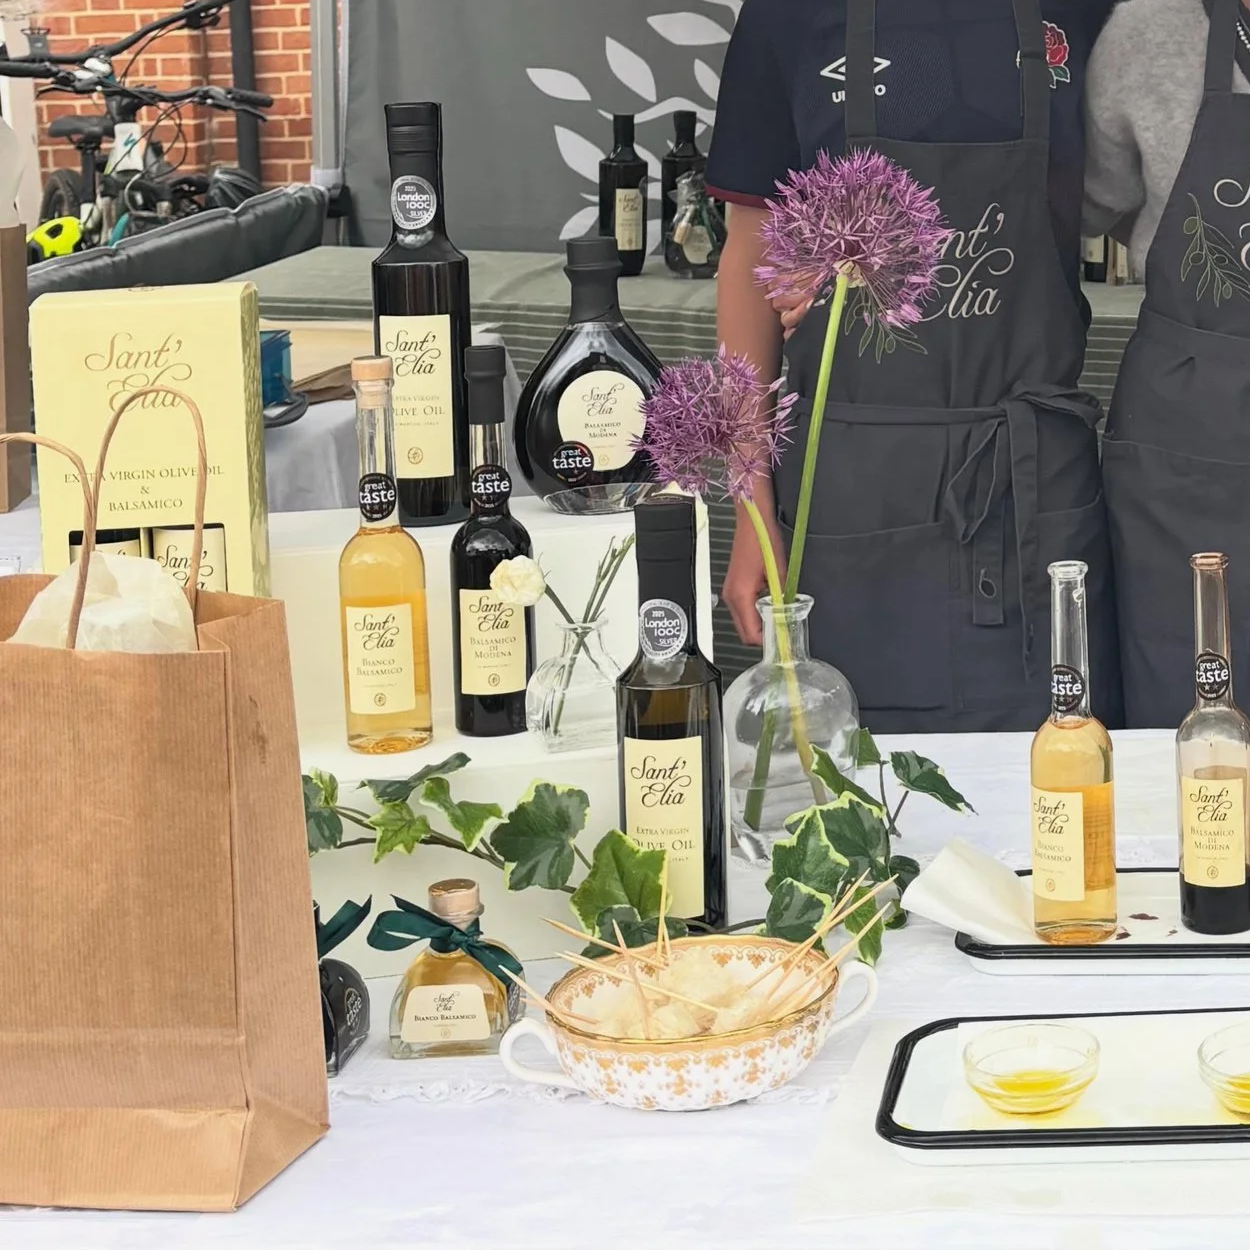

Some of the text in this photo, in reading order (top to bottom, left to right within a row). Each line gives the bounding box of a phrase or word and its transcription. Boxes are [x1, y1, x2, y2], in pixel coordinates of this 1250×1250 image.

[398, 192, 430, 201] London
[385, 330, 436, 352] Sant'
[84, 332, 183, 372] Sant'
[395, 348, 442, 377] Elia
[394, 407, 418, 416] LIVE
[560, 449, 582, 459] great
[552, 456, 592, 470] taste
[111, 468, 156, 482] VIRGIN
[158, 466, 198, 479] OLIVE
[478, 472, 500, 482] great
[140, 486, 150, 494] &
[364, 481, 386, 493] great
[471, 480, 510, 494] taste
[360, 490, 395, 504] taste
[109, 498, 183, 512] BALSAMICO
[469, 596, 506, 614] Sant
[354, 613, 396, 632] Sant'
[477, 607, 514, 632] Elia
[644, 618, 680, 628] London
[362, 626, 400, 651] Elia
[470, 637, 517, 646] BALSAMICO
[474, 650, 512, 659] MODENA
[362, 658, 396, 667] BIANCO
[1200, 660, 1220, 672] great
[356, 667, 403, 676] BALSAMICO
[1196, 667, 1229, 684] taste
[630, 755, 686, 780] Sant'
[640, 775, 692, 808] Elia
[1189, 785, 1229, 804] Sant'
[1196, 801, 1233, 822] Elia
[636, 826, 659, 836] EXTRA
[1038, 815, 1070, 835] Elia
[1190, 826, 1234, 836] BALSAMICO
[672, 839, 695, 850] OIL
[1194, 842, 1230, 850] MODENA
[414, 1014, 438, 1022] BIANCO
